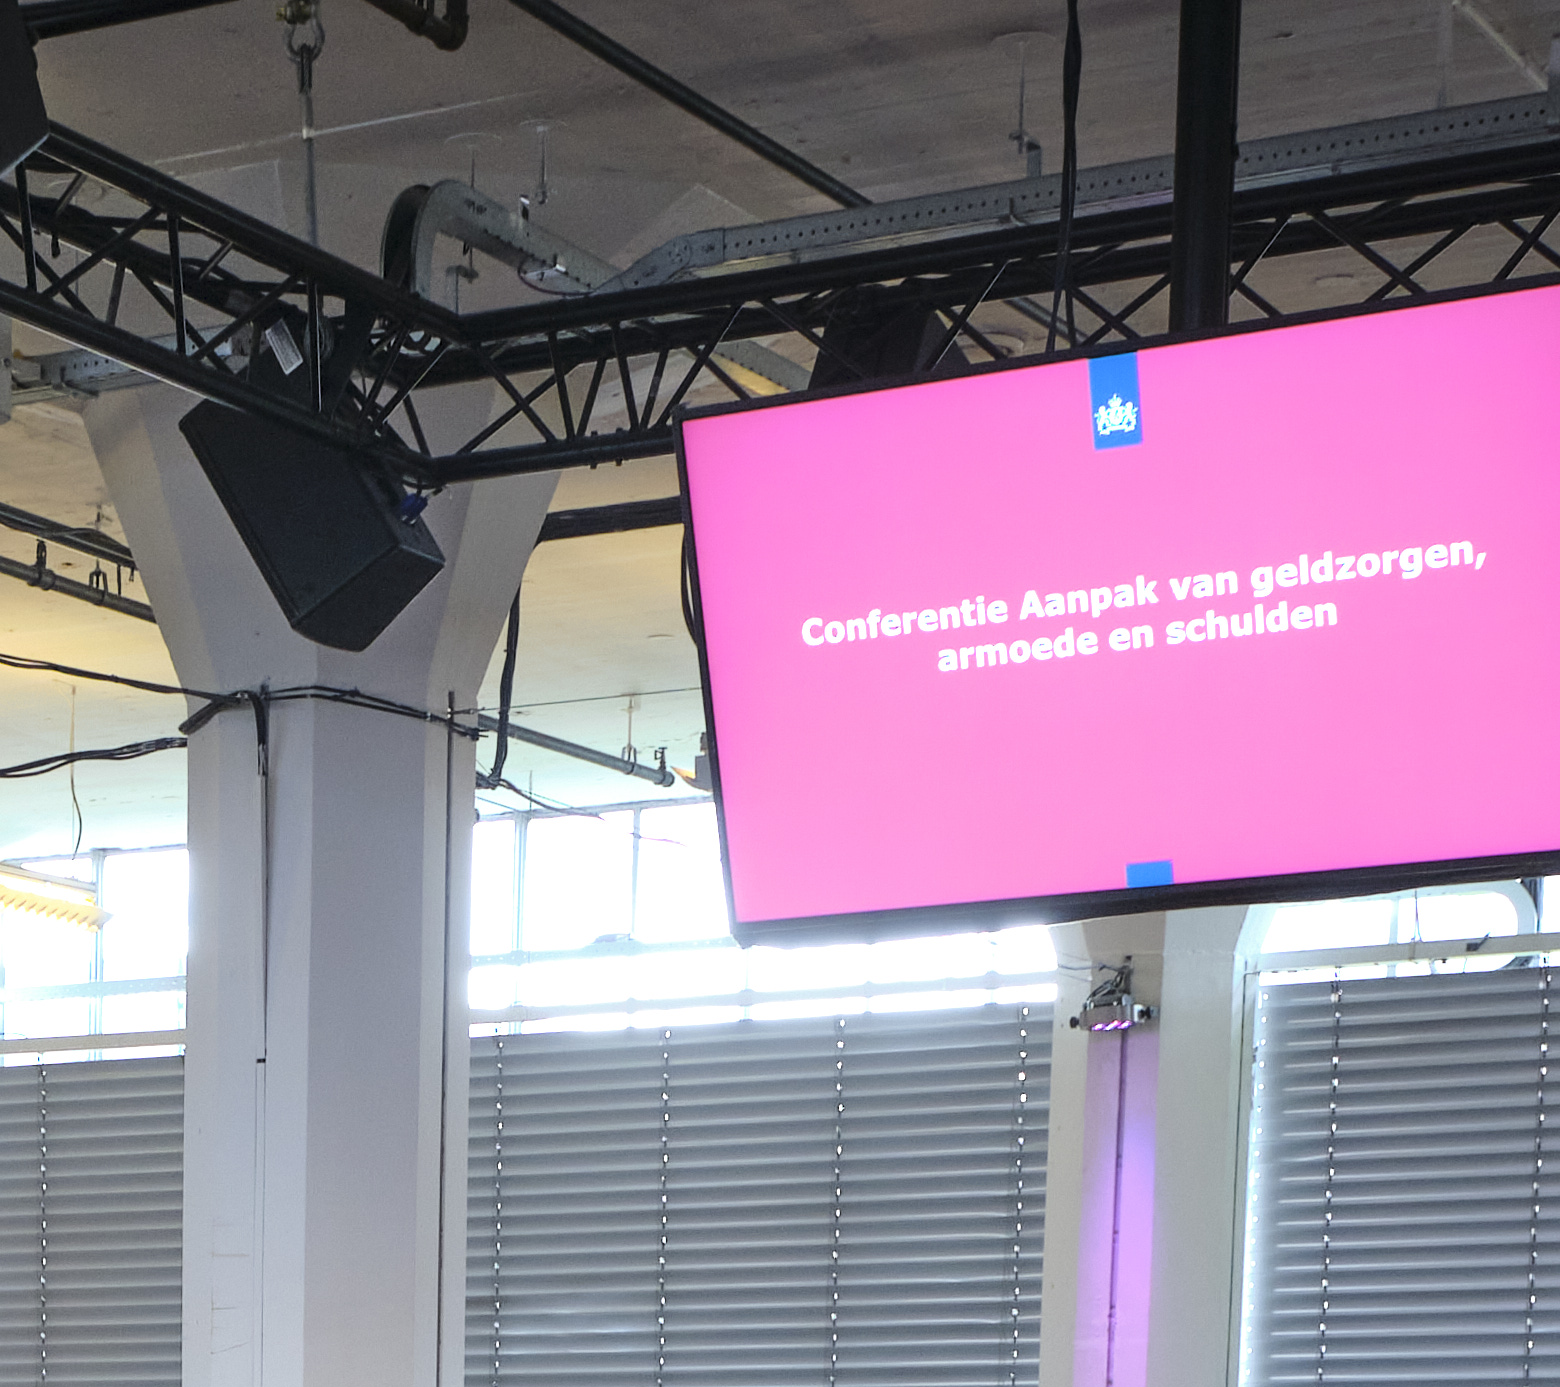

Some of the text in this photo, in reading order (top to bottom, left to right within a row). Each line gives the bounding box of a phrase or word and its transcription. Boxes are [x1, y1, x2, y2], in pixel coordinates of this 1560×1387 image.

[801, 540, 1487, 647] Conferentie Aanpak van geldzorgen,
[937, 600, 1338, 673] armoede en schulden
